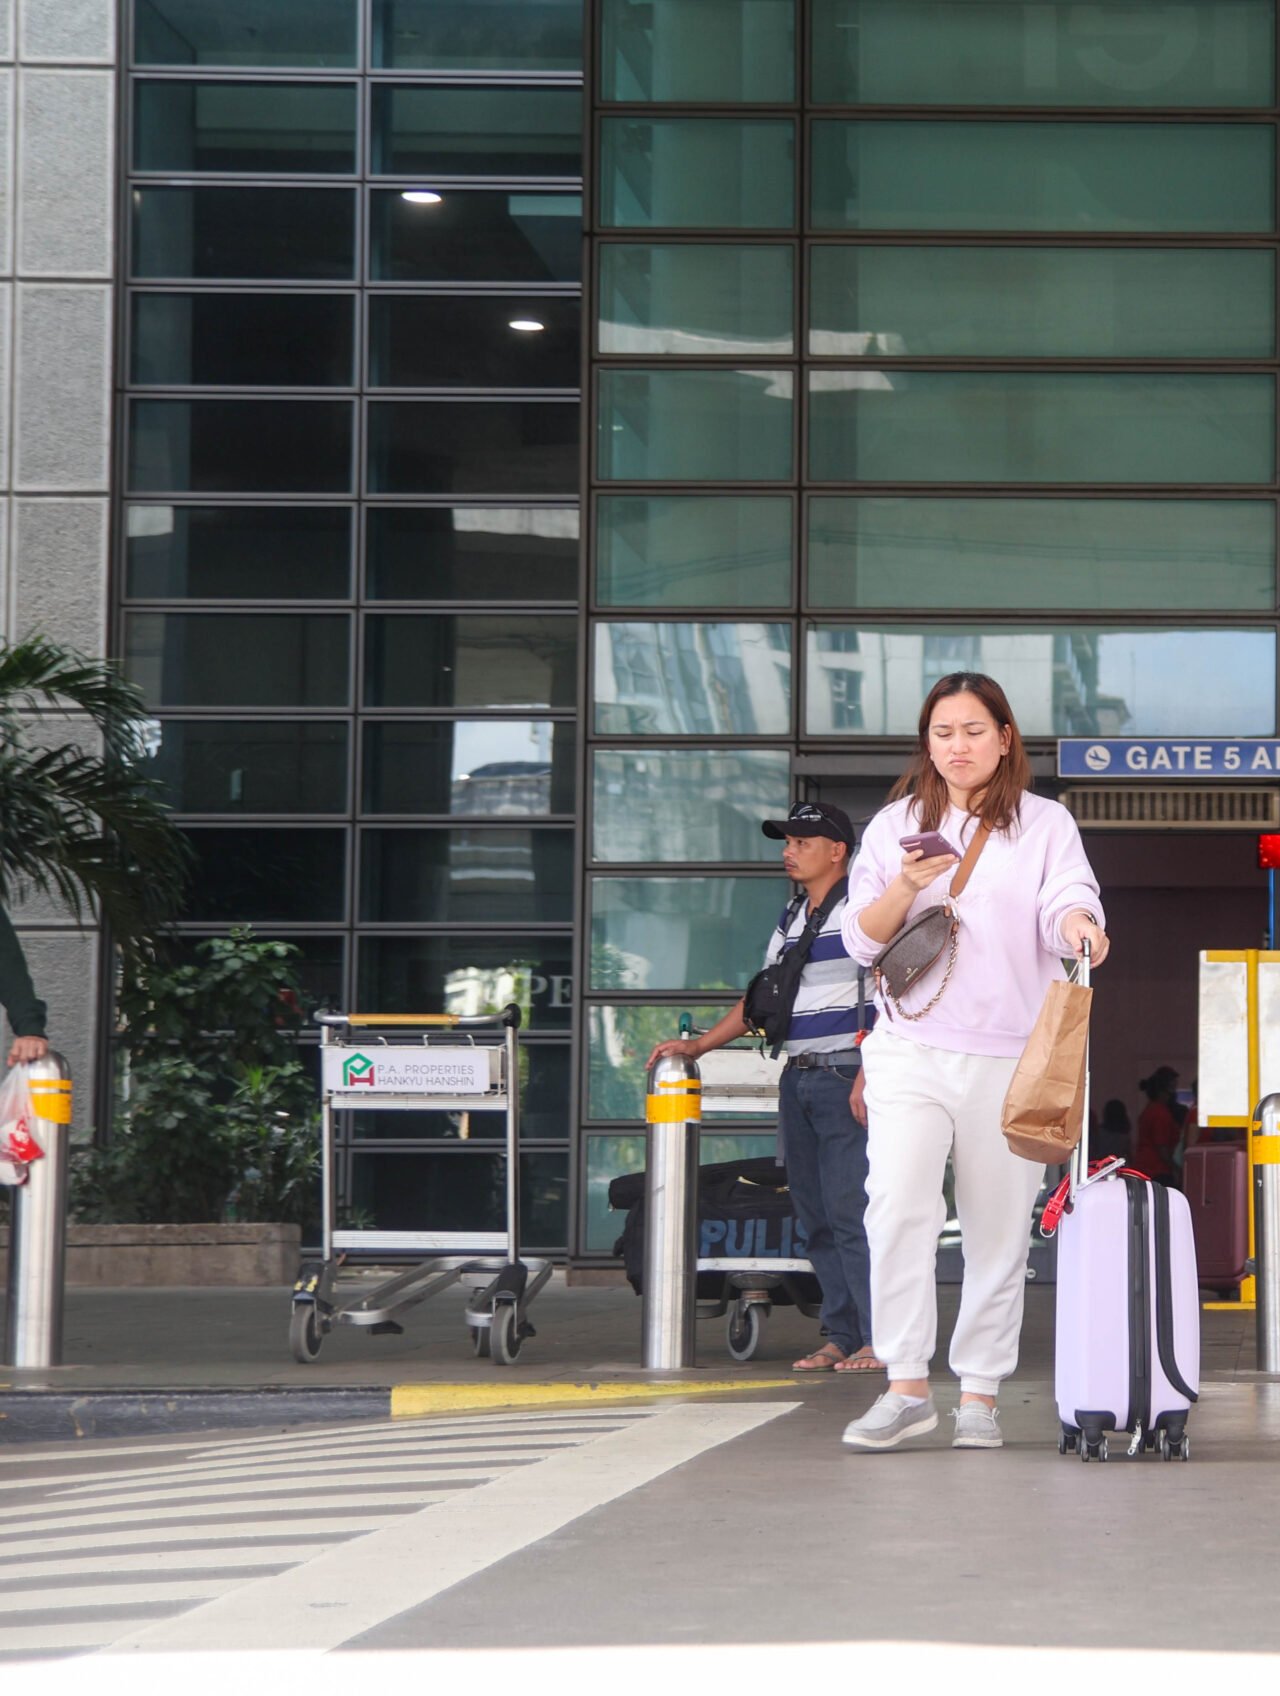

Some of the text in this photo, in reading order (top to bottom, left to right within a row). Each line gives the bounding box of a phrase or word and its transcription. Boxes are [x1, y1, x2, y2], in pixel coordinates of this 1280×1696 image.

[1126, 746, 1213, 771] GATE
[1223, 747, 1241, 771] 5
[377, 1064, 475, 1076] P.A. PROPERTIES
[377, 1076, 475, 1087] HANKYU HANSHIN
